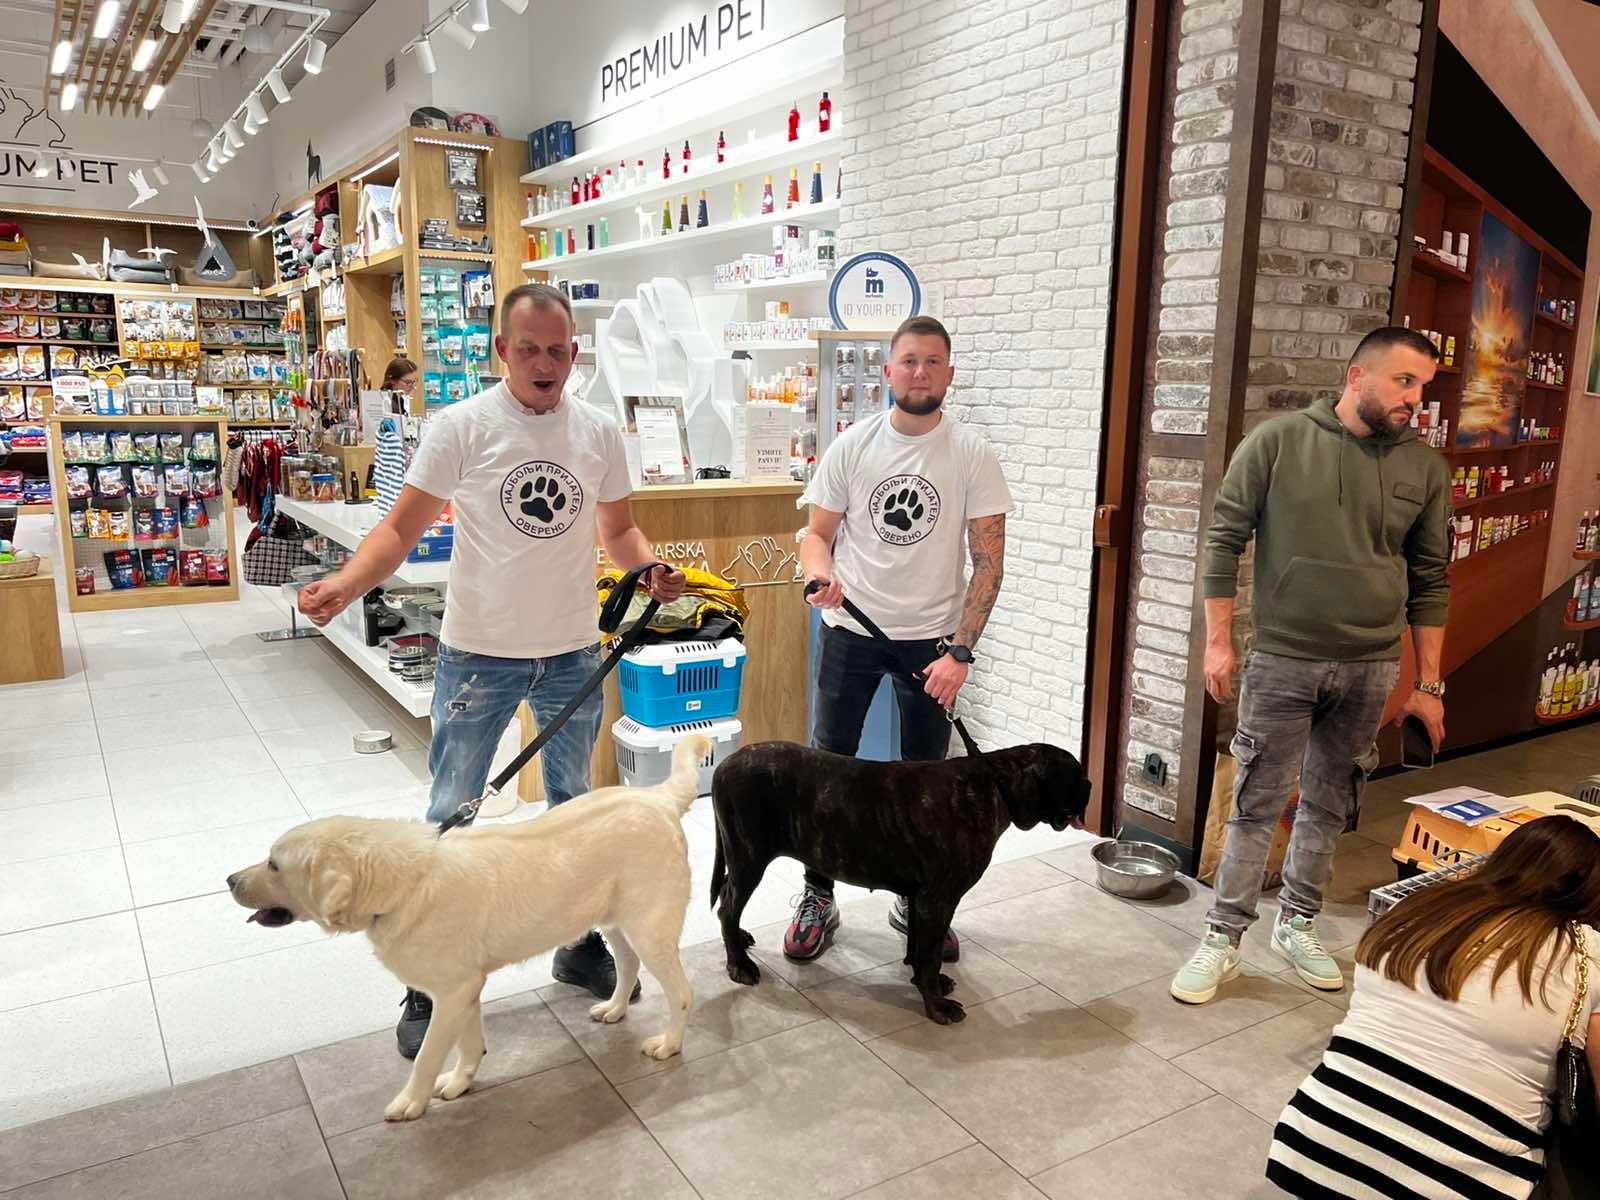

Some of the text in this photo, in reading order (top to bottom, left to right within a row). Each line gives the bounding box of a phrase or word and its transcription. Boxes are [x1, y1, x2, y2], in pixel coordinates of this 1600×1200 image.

[602, 14, 707, 103] PREMIUM
[56, 157, 119, 184] PET
[844, 303, 904, 317] ID YOUR PET
[504, 464, 580, 515] НАЈБОЉИ ПРИЈАТЕЉ
[872, 477, 908, 514] НАЈБОЉИ
[516, 517, 565, 535] ОВЕРЕНО
[879, 526, 922, 543] ОВЕРЕНО
